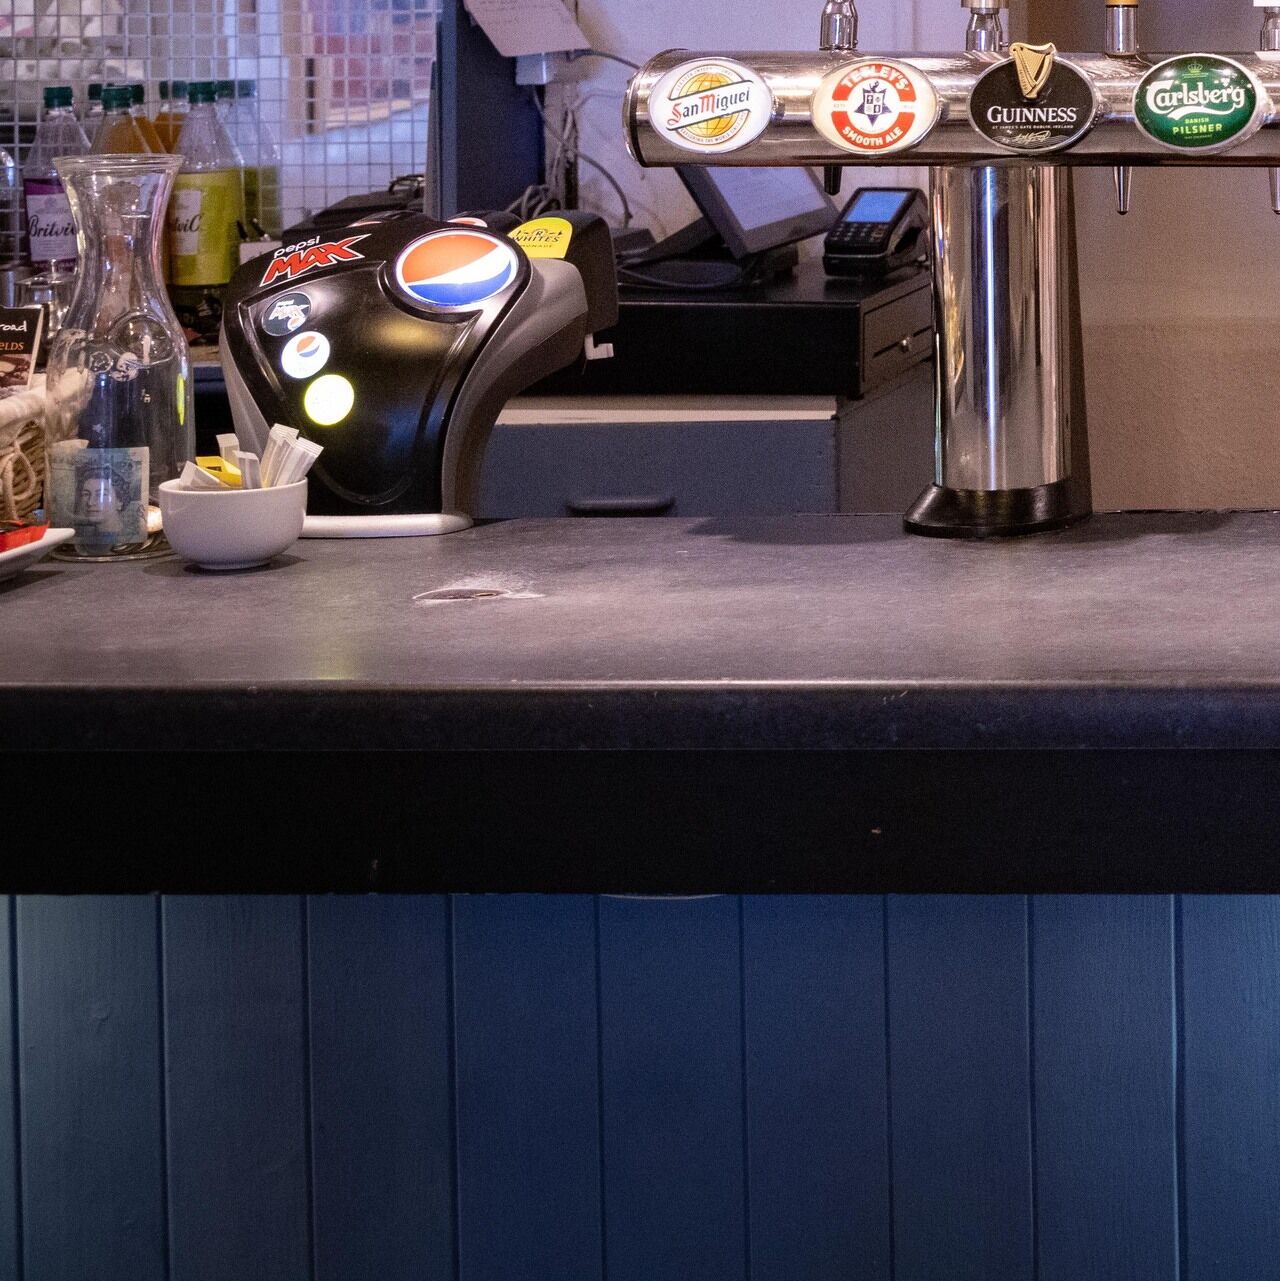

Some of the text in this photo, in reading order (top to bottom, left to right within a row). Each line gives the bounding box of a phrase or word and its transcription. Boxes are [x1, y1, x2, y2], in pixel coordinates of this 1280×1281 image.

[667, 86, 751, 127] San Miguel
[1145, 79, 1246, 115] Carlsberg
[986, 105, 1078, 124] GUINNESS
[842, 126, 904, 147] SMOOTH ALE
[1172, 123, 1224, 136] PILSNER
[273, 235, 321, 259] pepsi
[259, 233, 373, 288] MAX
